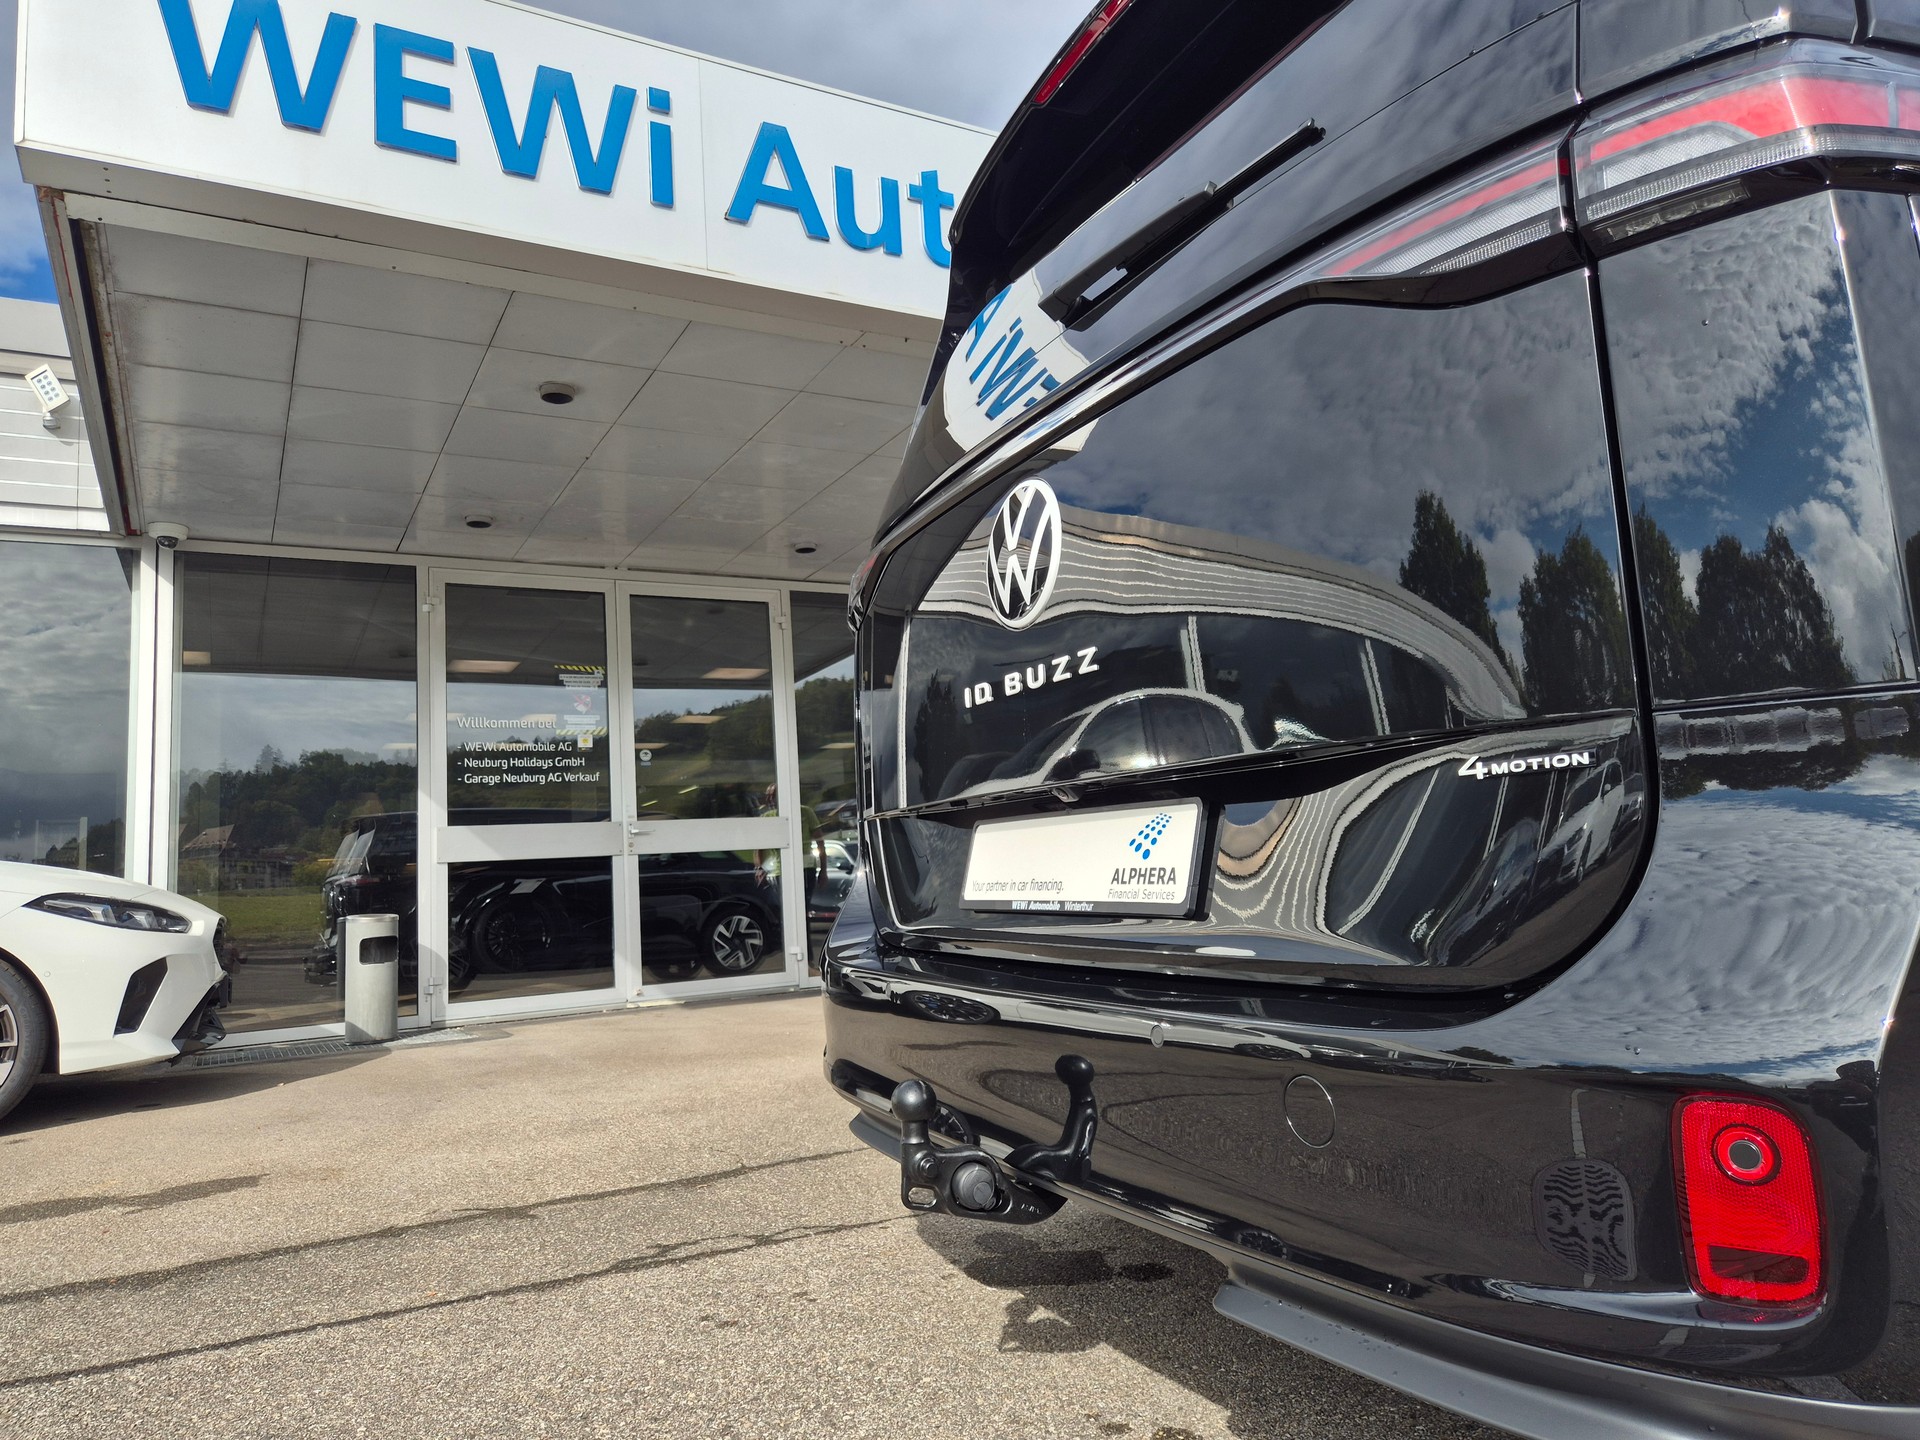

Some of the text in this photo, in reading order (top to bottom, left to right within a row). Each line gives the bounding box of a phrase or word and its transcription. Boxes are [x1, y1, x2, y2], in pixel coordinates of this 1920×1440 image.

[156, 0, 674, 208] WEWi
[1003, 645, 1100, 697] BUZZ
[457, 717, 535, 729] Willkommen
[538, 717, 557, 729] bei
[464, 742, 497, 752] WEWi
[500, 741, 556, 752] Automobile
[558, 742, 572, 752] AG
[464, 757, 508, 770] Neuburg
[510, 757, 553, 770] Holidays
[555, 757, 585, 767] GmbH
[1458, 752, 1590, 780] 4MOTION
[464, 774, 501, 786] Garage
[503, 773, 546, 785] Neuburg
[547, 773, 562, 783] AG
[563, 772, 600, 783] Verkauf
[1110, 867, 1177, 885] ALPHERA
[972, 878, 1064, 894] Your partner in car financing.
[1107, 888, 1176, 901] Financial Services
[1011, 900, 1095, 912] WEWi Automobile Winterthur
